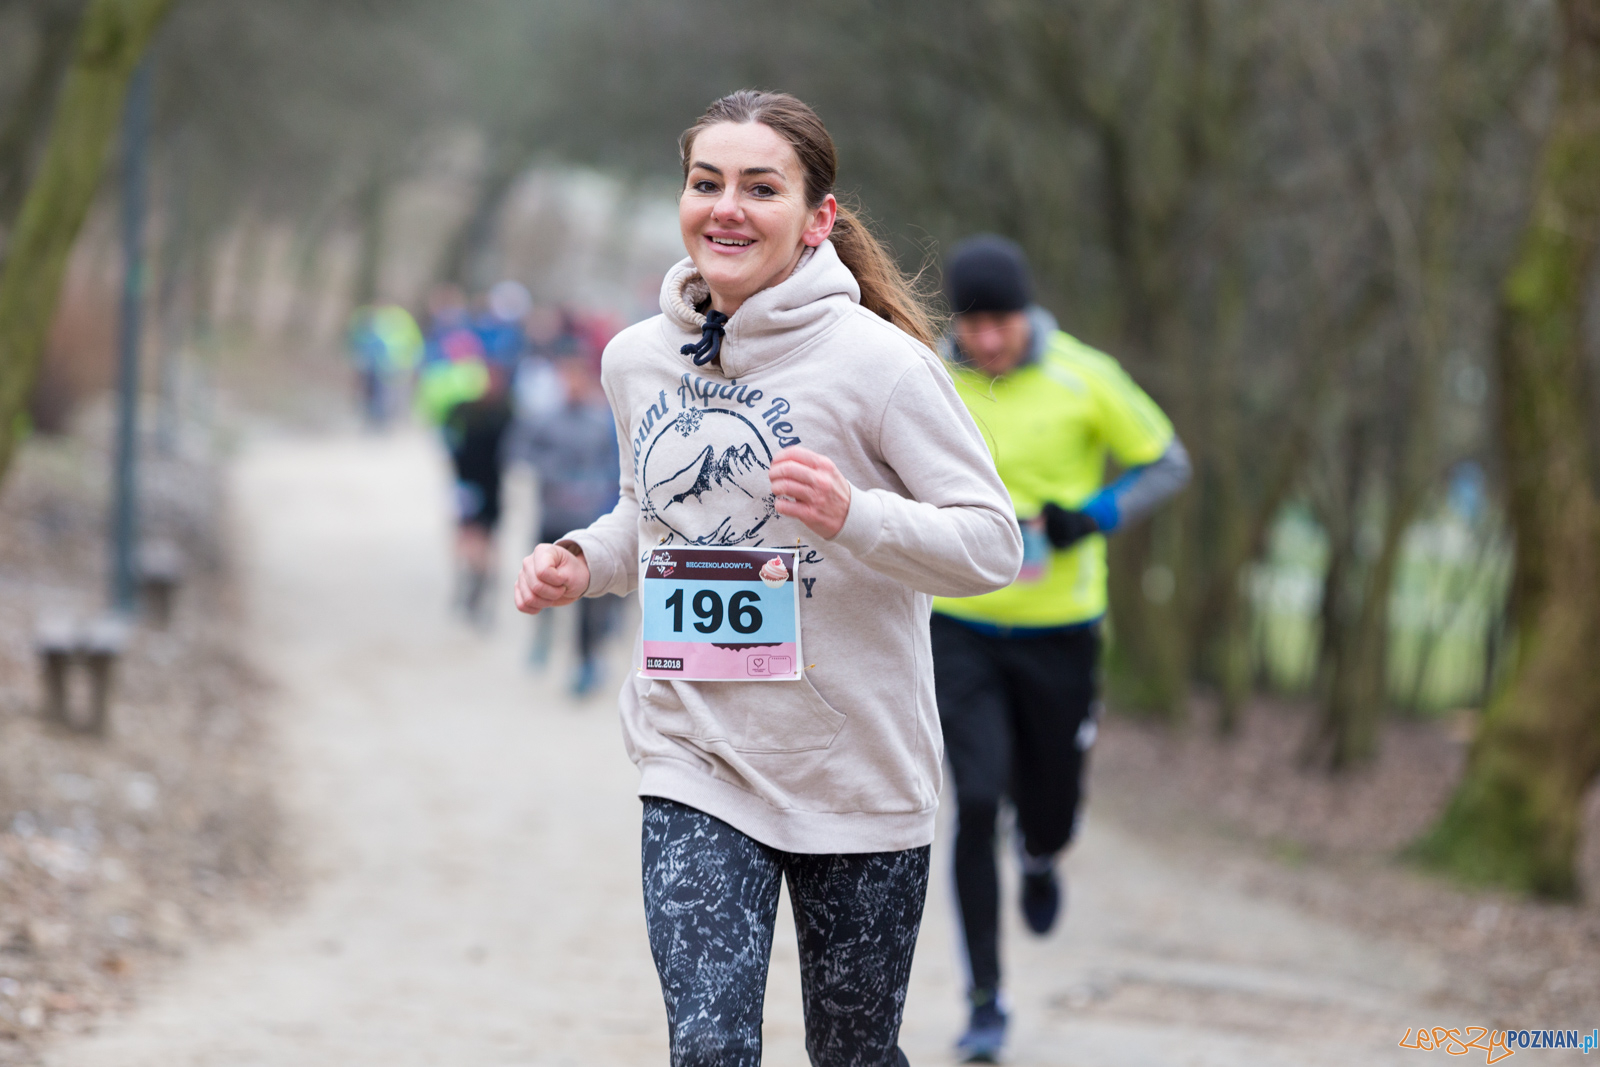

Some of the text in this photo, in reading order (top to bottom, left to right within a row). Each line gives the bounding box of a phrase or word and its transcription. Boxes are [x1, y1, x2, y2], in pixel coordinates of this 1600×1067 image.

[677, 372, 764, 409] Alpine
[761, 397, 802, 450] Res
[685, 561, 753, 570] BIEGCZEKOLADOWY.PL
[665, 588, 763, 635] 196
[647, 658, 682, 670] 11.02.2018
